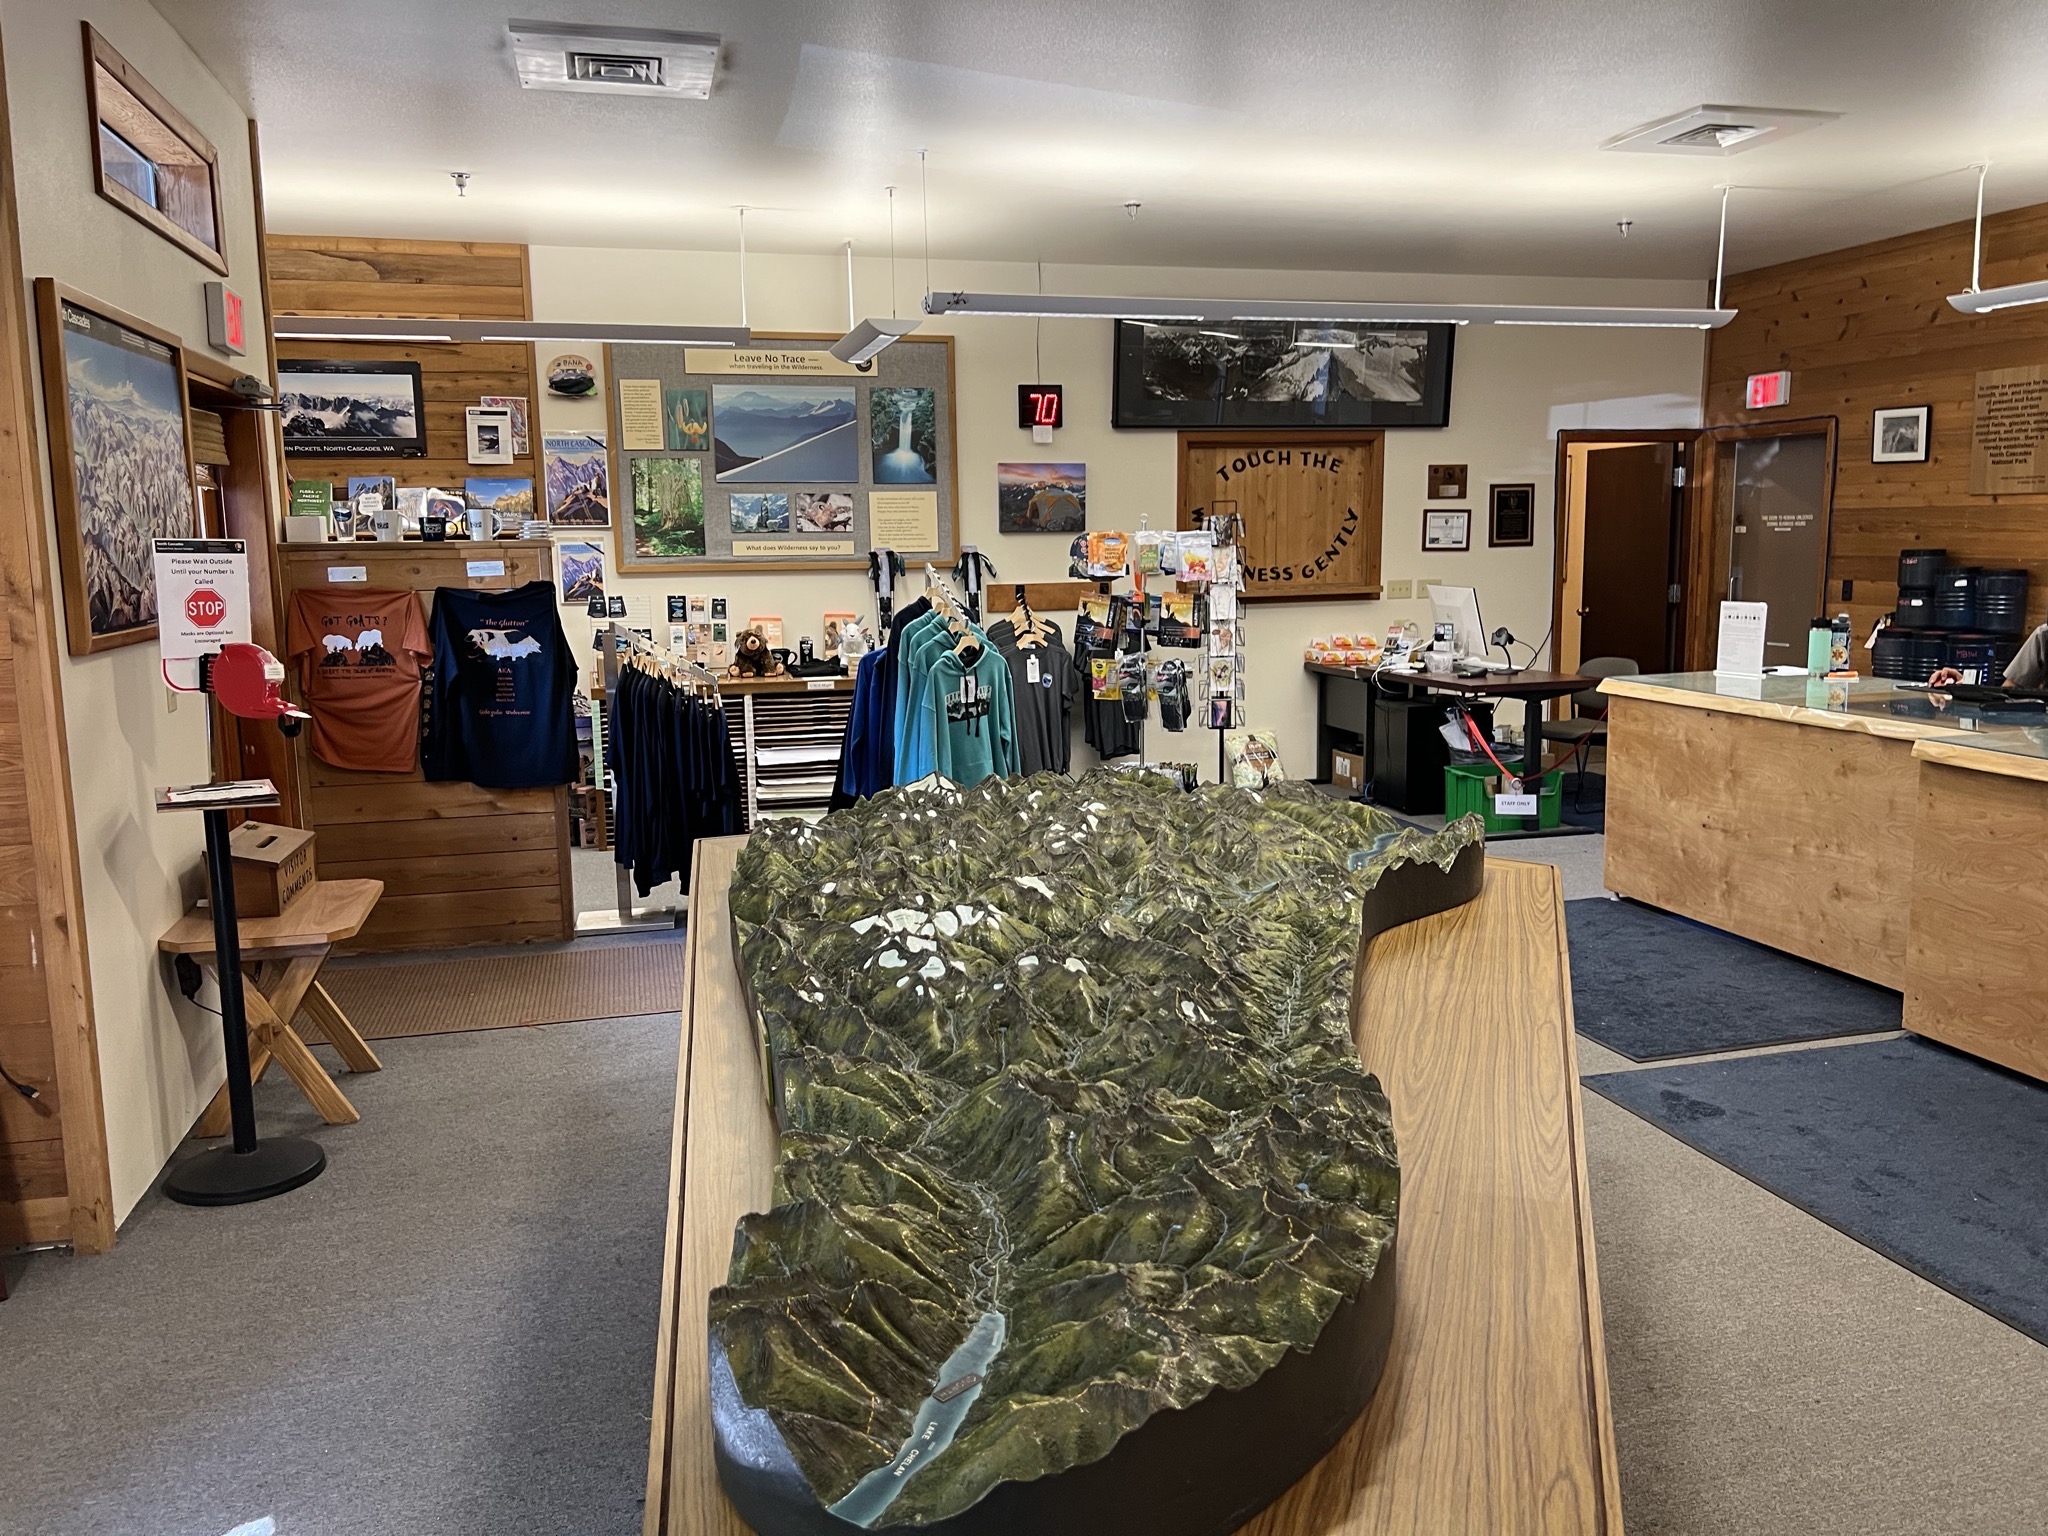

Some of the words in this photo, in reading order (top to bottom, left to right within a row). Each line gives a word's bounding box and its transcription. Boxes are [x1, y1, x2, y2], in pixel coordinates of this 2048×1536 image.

[68, 308, 90, 329] Cascades
[734, 354, 762, 362] Leave
[765, 354, 778, 362] No
[781, 354, 806, 363] Trace
[1752, 373, 1780, 406] EXIT
[1030, 394, 1058, 423] 70
[546, 440, 569, 448] NORTH
[1216, 450, 1291, 482] TOUCH
[1300, 451, 1344, 474] THE
[1302, 507, 1358, 580] GENTLY
[188, 601, 223, 616] STOP
[321, 616, 342, 627] GOT
[284, 848, 307, 878] VISITOR
[282, 866, 313, 903] COMMENTS
[921, 1421, 938, 1440] LAKE
[893, 1449, 919, 1477] CHELAN
